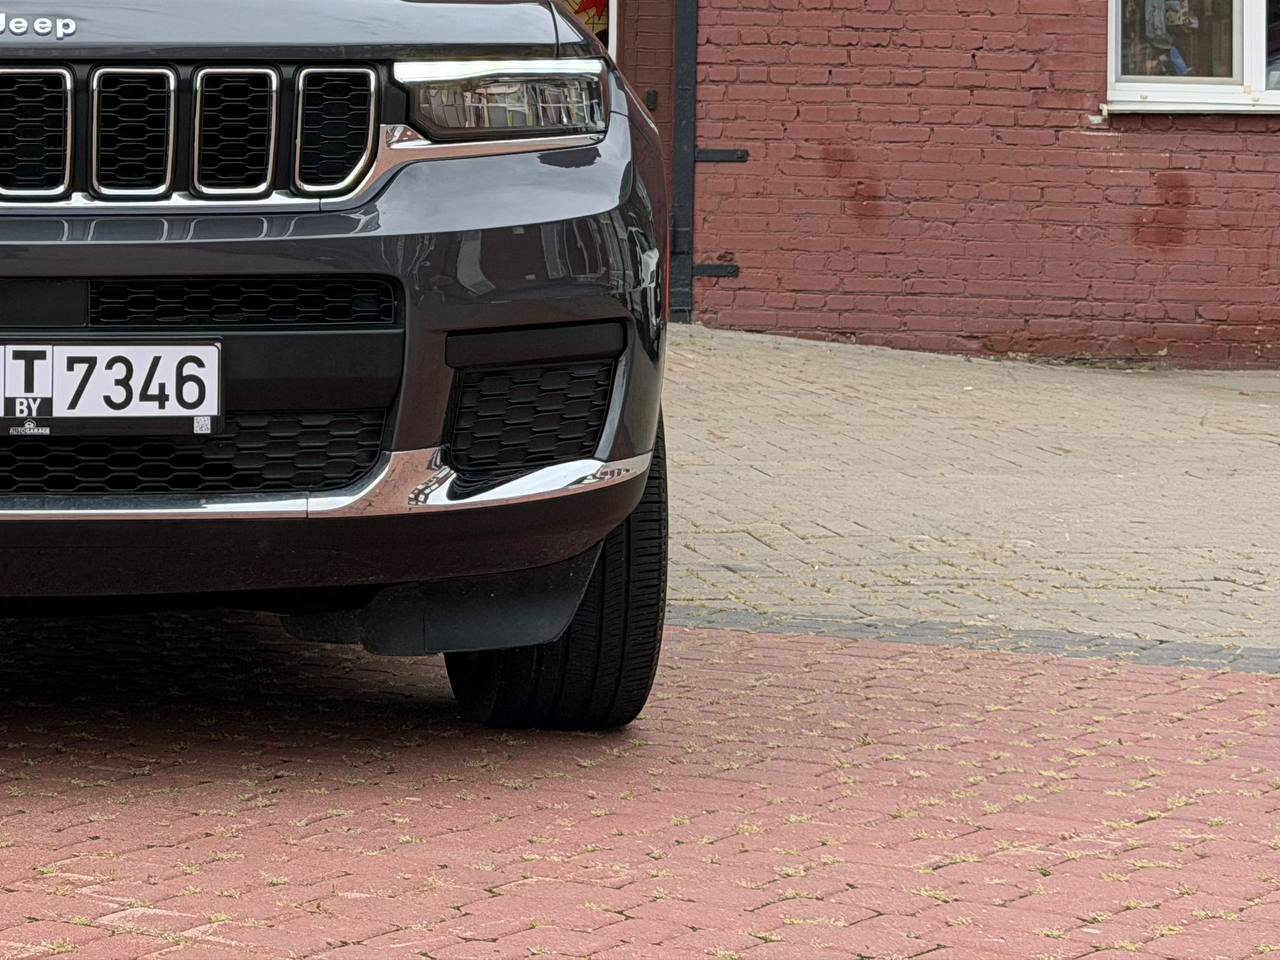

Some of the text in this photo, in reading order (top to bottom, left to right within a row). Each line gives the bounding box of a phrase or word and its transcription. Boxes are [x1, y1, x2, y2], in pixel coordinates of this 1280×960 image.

[11, 350, 47, 394] T
[66, 354, 207, 410] 7346
[15, 398, 41, 417] BY
